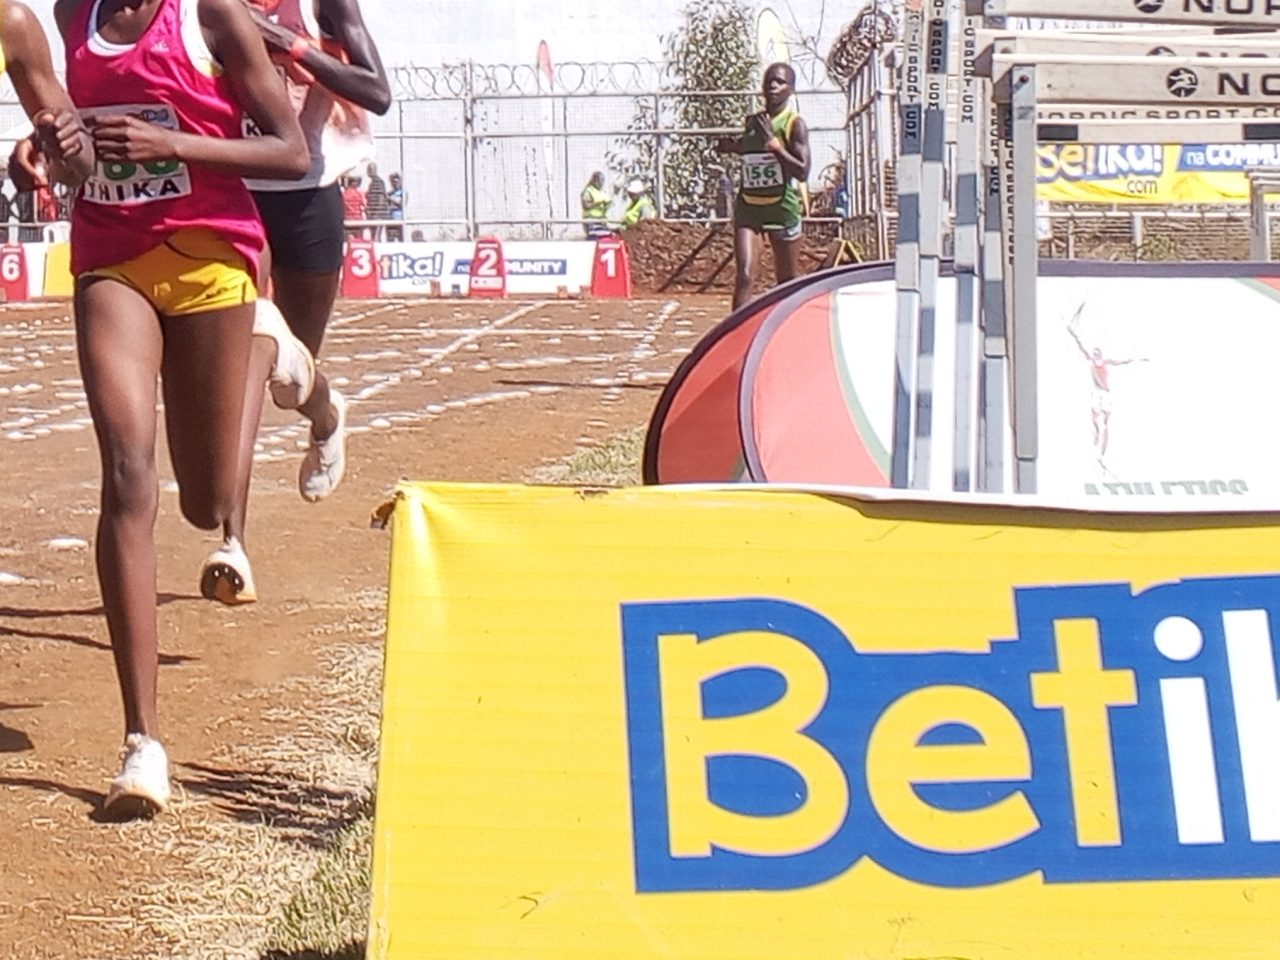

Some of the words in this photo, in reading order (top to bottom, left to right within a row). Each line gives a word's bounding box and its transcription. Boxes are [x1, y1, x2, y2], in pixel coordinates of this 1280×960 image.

[1186, 151, 1204, 164] na
[2, 253, 21, 281] 6
[351, 248, 371, 277] 3
[380, 251, 442, 279] tika!
[477, 248, 498, 276] 2
[506, 260, 562, 273] MUNITY
[600, 248, 616, 277] 1
